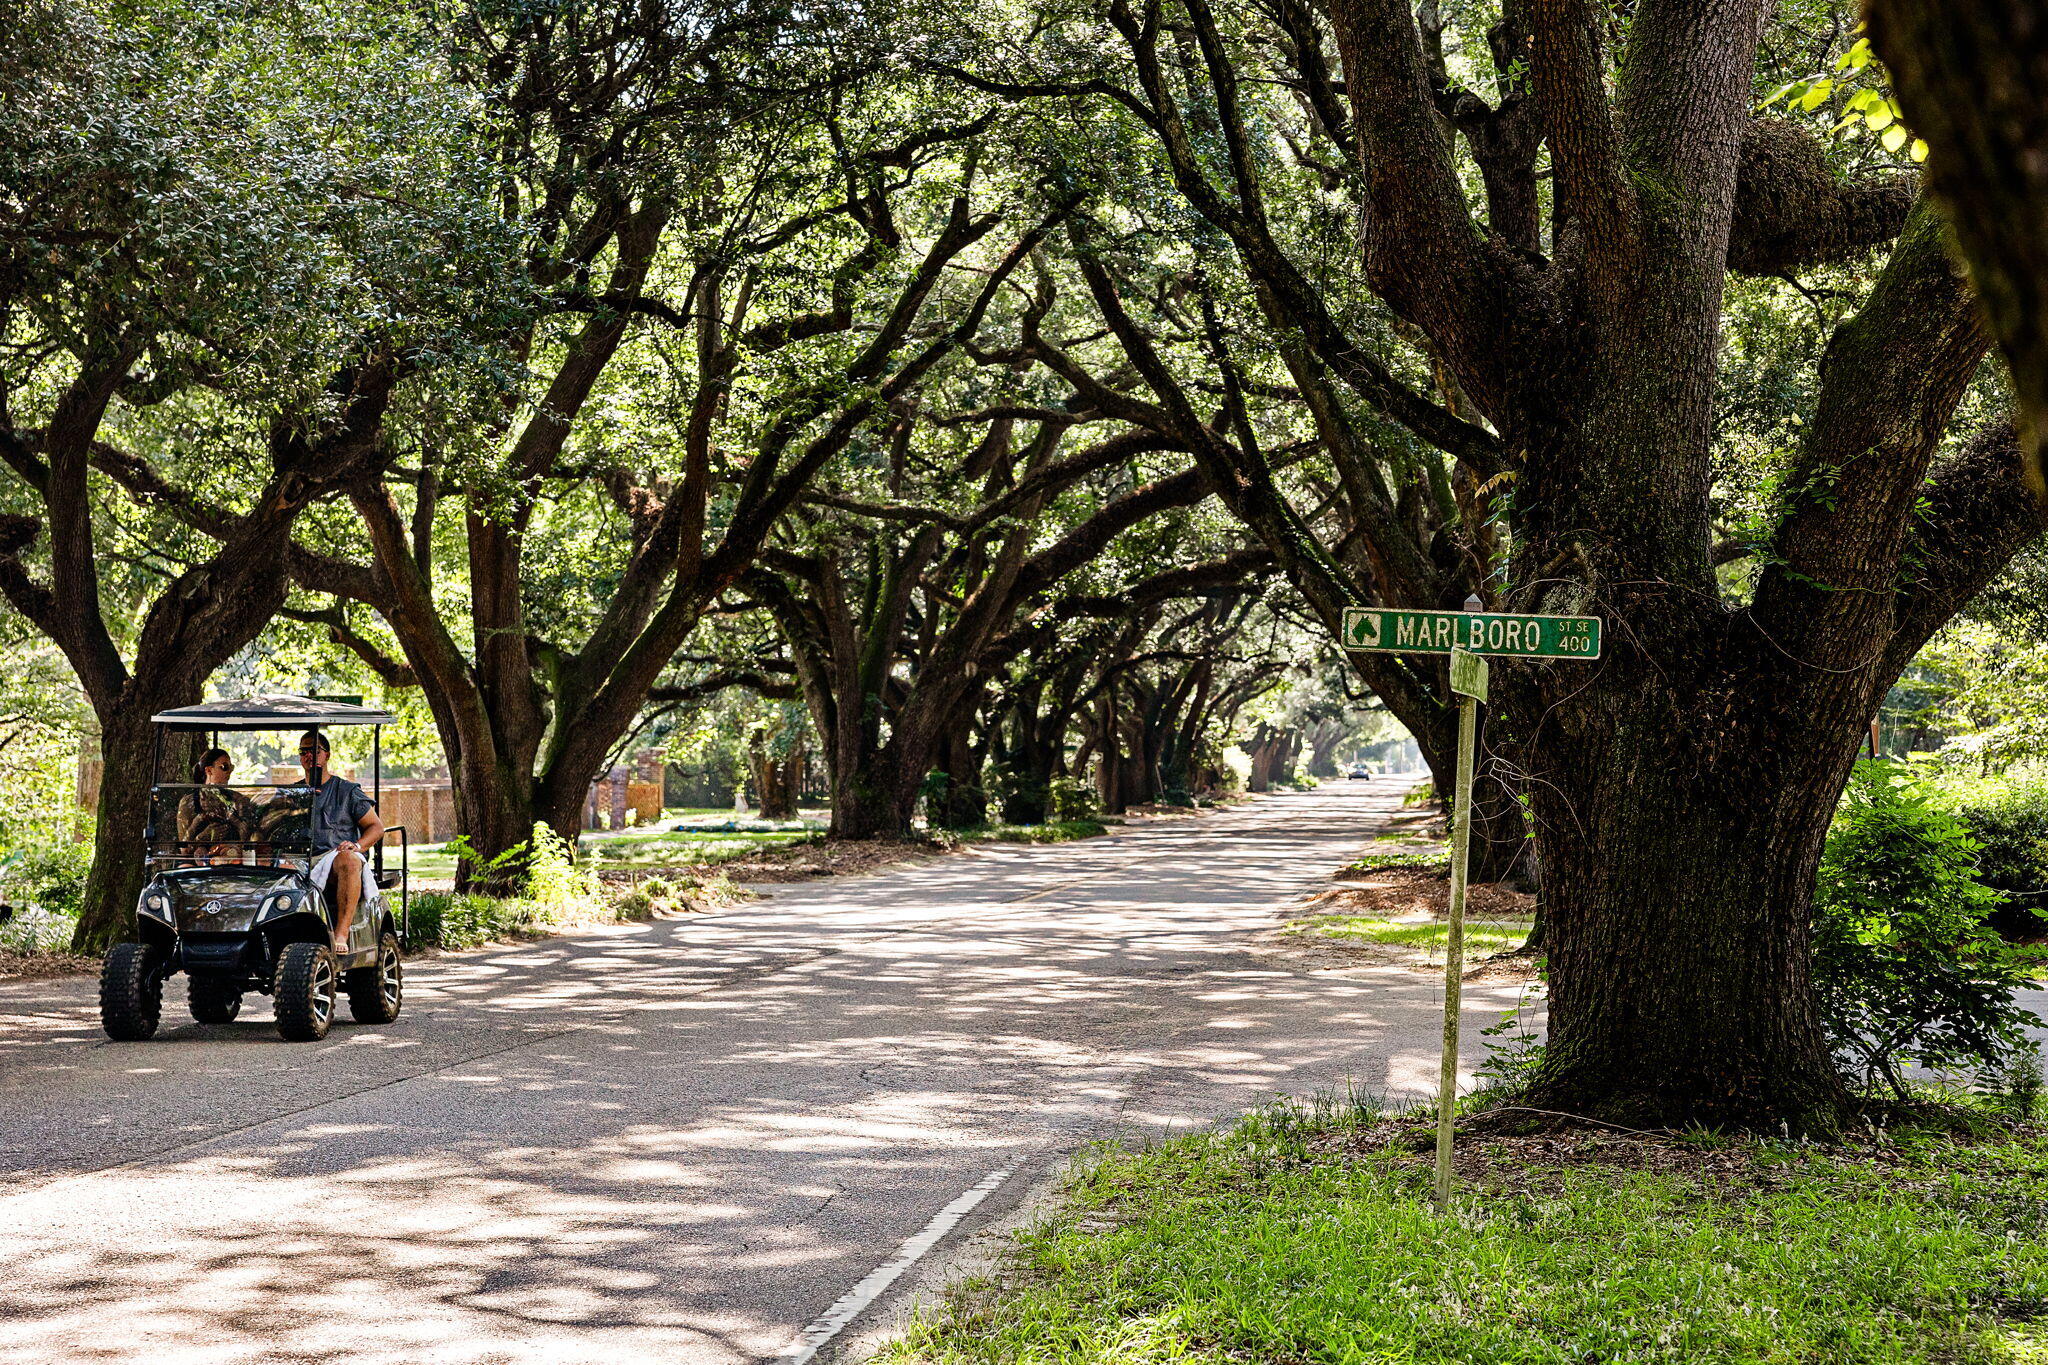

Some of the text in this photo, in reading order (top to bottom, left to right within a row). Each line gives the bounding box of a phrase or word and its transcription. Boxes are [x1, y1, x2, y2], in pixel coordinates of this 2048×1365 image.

[1397, 615, 1540, 651] MARLBORO
[1558, 621, 1589, 633] ST SE
[1558, 636, 1590, 652] 400
